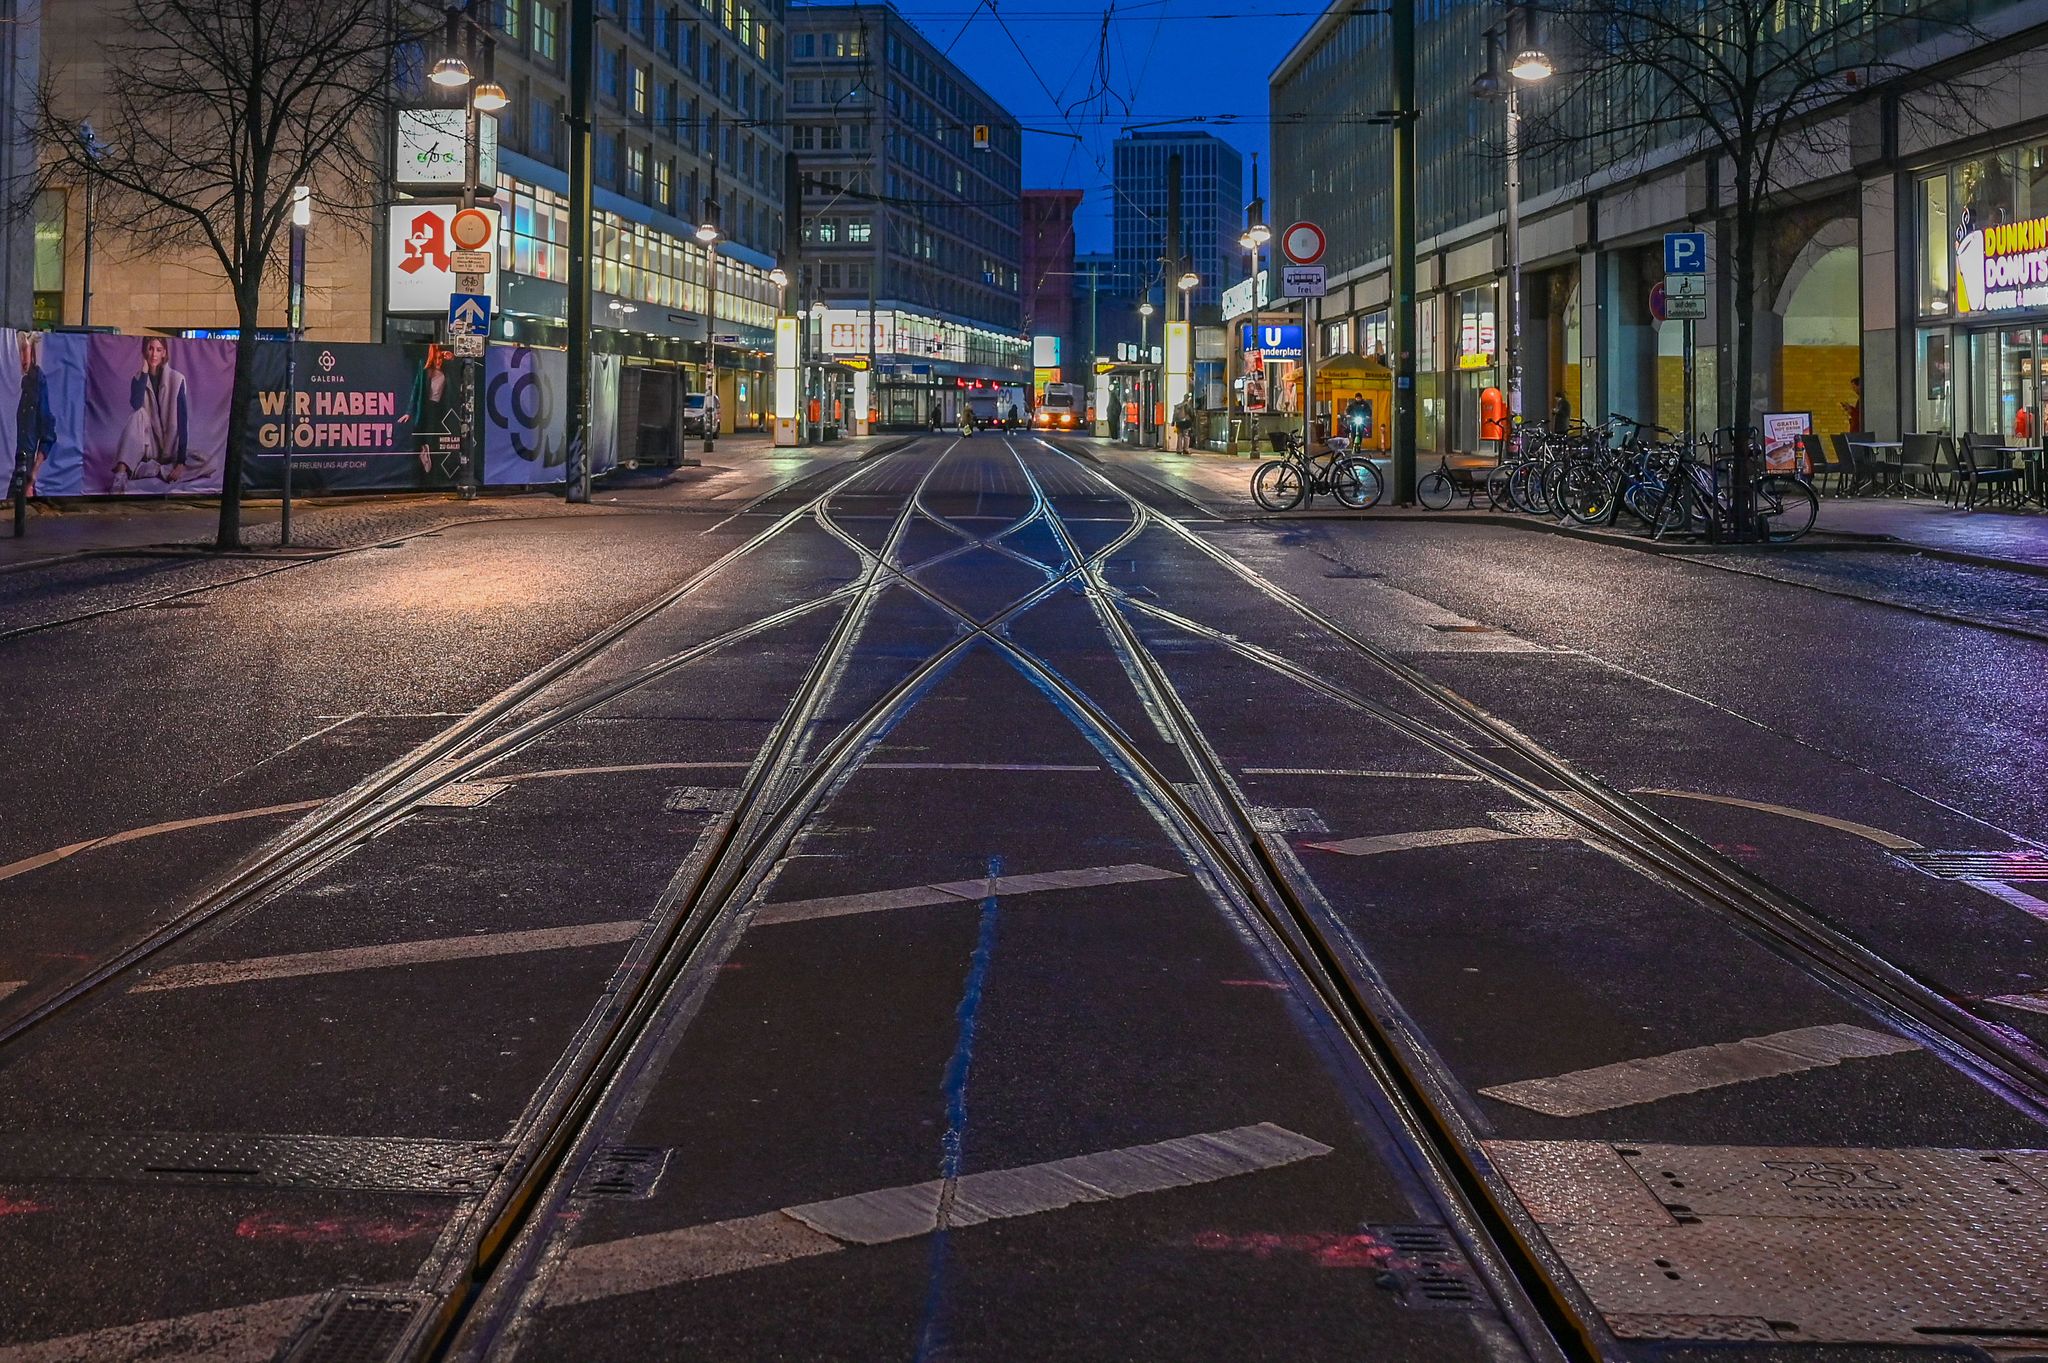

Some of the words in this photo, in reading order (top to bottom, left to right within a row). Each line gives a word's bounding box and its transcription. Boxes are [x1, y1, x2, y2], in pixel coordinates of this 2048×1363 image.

[1674, 238, 1696, 269] P
[1985, 249, 2048, 288] DONUTS
[1297, 286, 1312, 294] frei
[1265, 327, 1282, 347] U
[310, 375, 345, 383] GALERIA
[258, 391, 311, 416] WR
[315, 391, 395, 416] HABEN
[299, 461, 322, 469] FREUEN
[322, 461, 336, 469] UNS
[336, 461, 349, 469] AUF
[349, 460, 367, 469] DICH!
